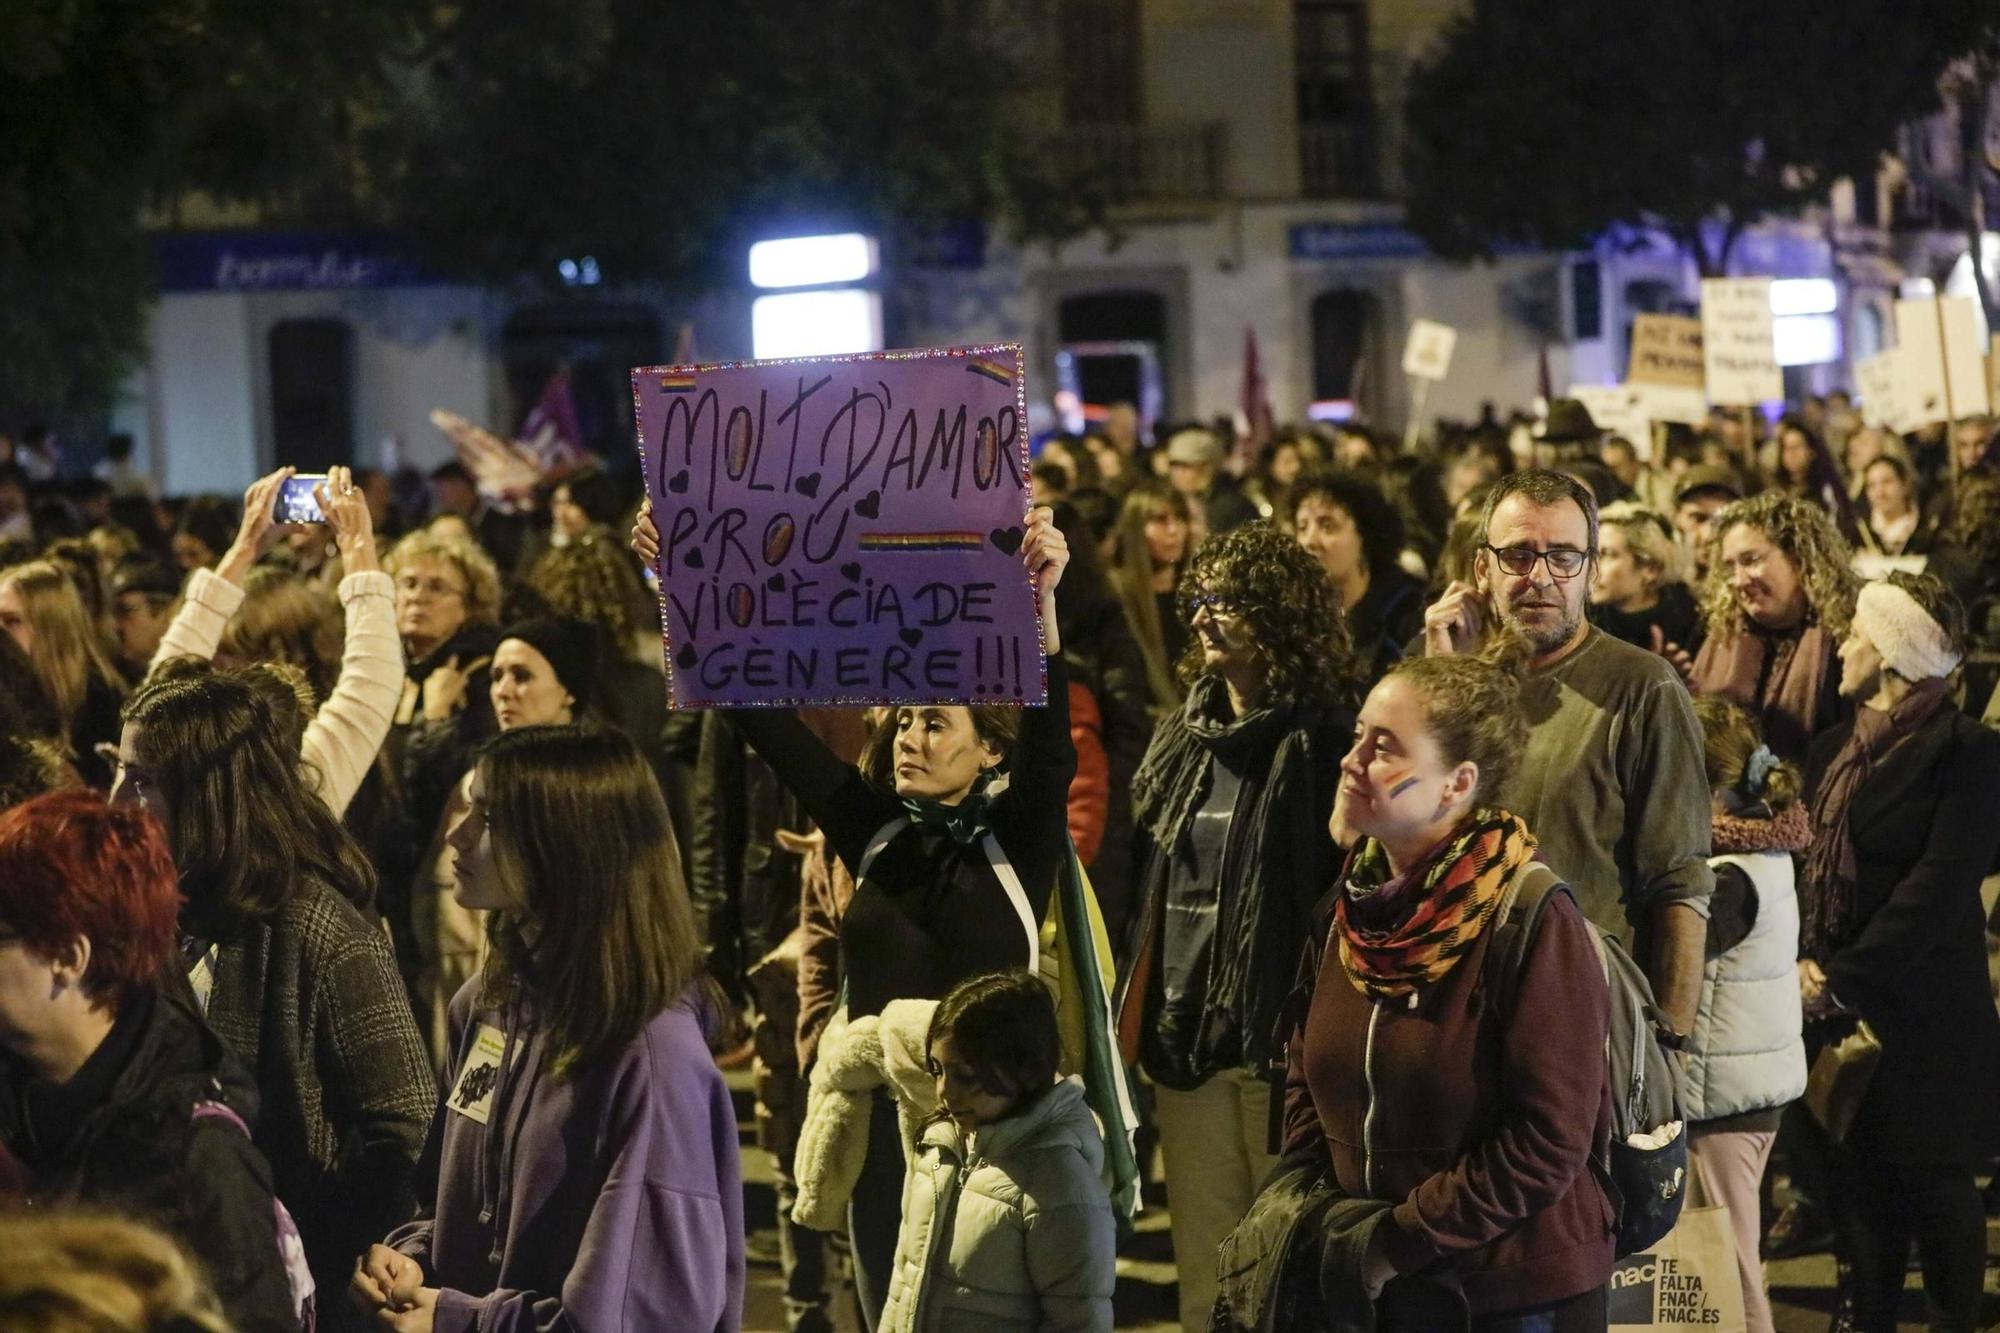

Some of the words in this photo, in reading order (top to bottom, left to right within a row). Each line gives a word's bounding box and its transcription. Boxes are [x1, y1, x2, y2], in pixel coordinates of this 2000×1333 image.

[659, 375, 832, 513] MOLT
[820, 381, 1025, 525] D'AMOR
[667, 506, 850, 577] PROU
[911, 581, 997, 628] DE
[1660, 1259, 1679, 1274] TE
[1610, 1264, 1657, 1291] nac
[1660, 1275, 1703, 1291] FALTA
[1659, 1292, 1698, 1307] FNAC
[1658, 1308, 1721, 1324] FNAC.ES
